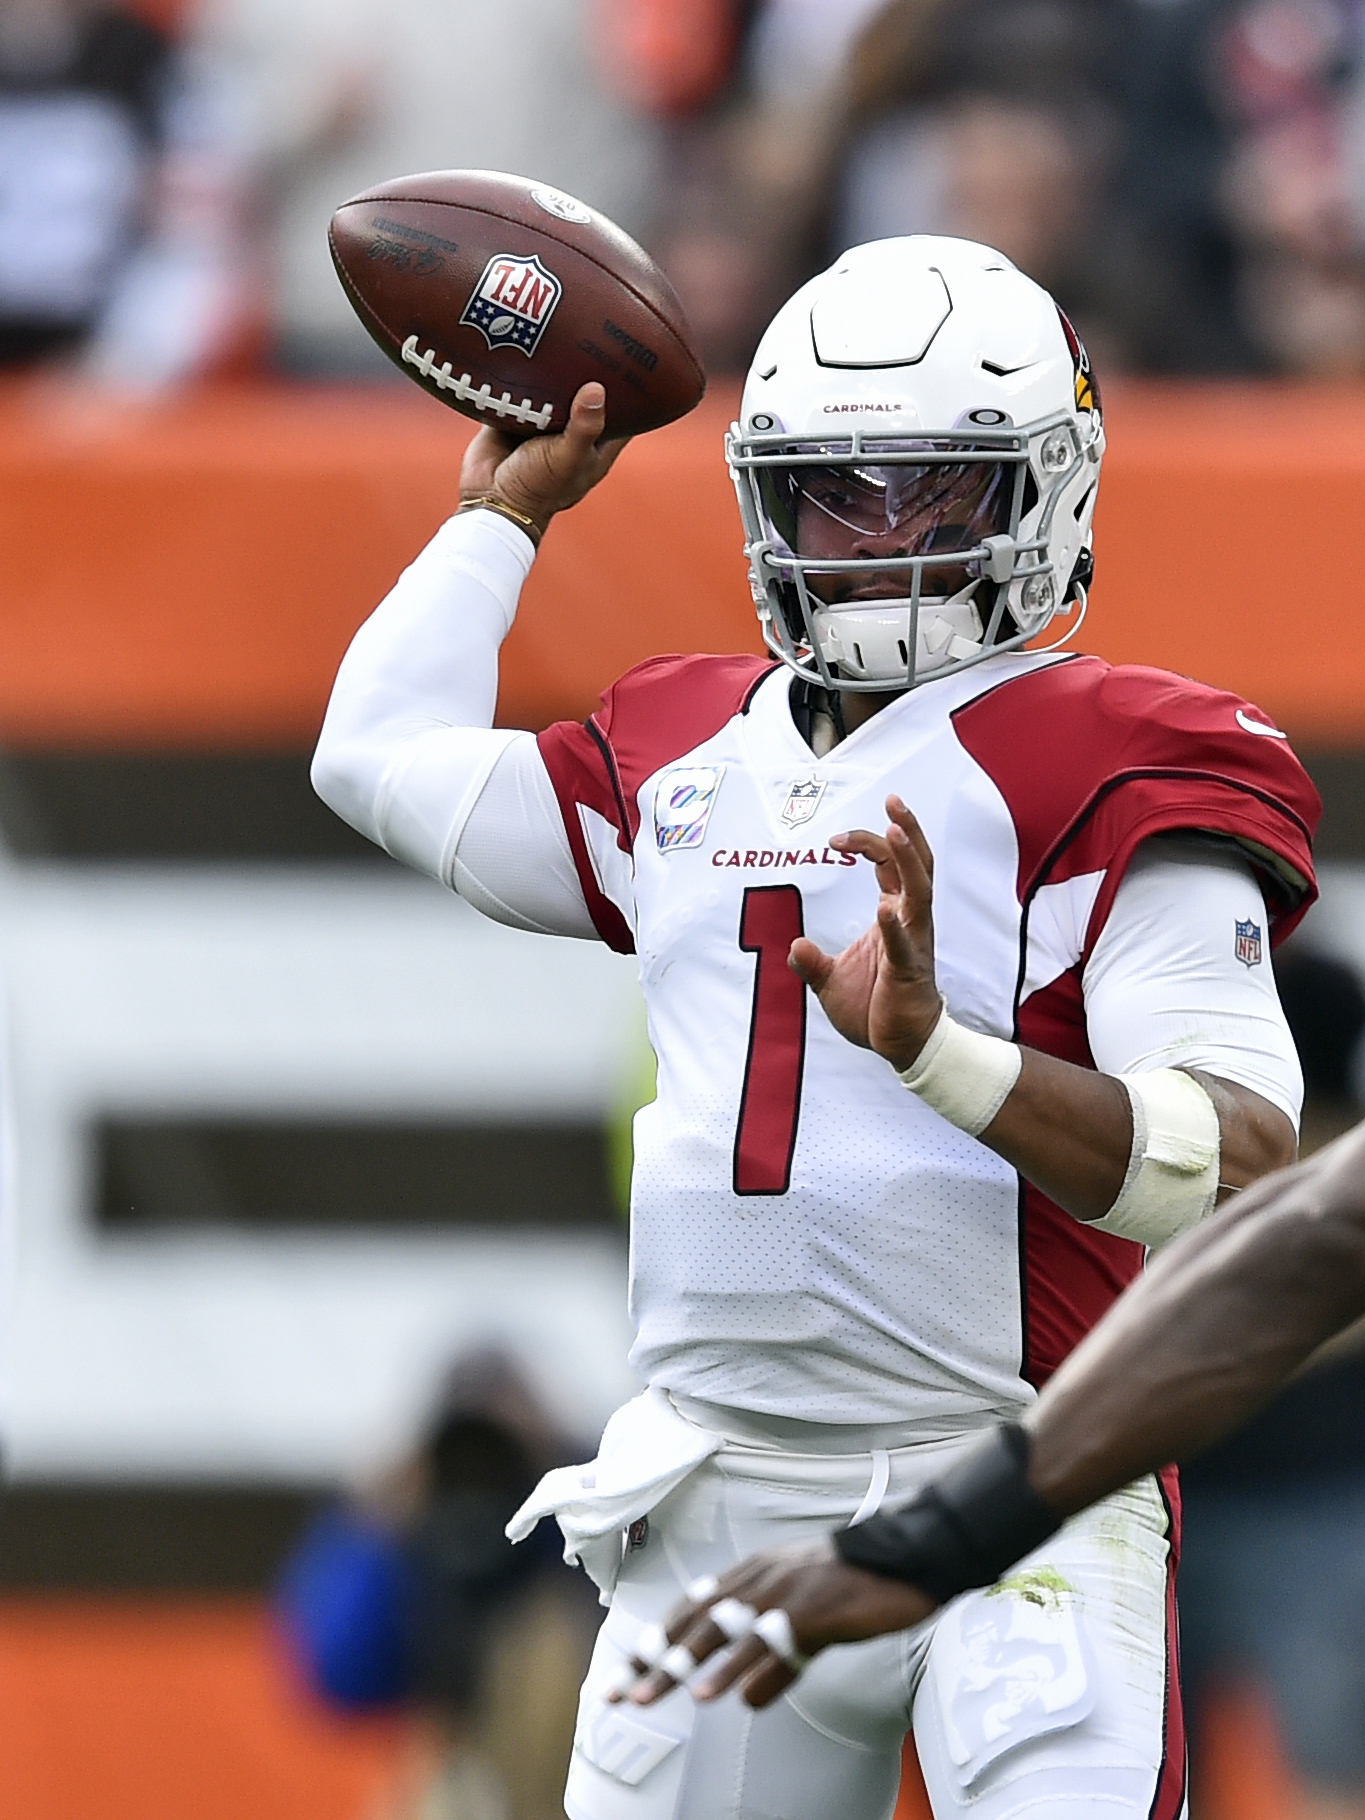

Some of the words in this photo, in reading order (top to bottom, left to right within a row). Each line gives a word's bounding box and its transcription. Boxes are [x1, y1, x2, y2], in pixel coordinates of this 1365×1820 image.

[490, 264, 552, 320] NFL
[823, 404, 902, 413] CARDINALS
[712, 848, 857, 867] CARDINALS
[1238, 937, 1260, 961] NFL
[733, 884, 808, 1196] 1
